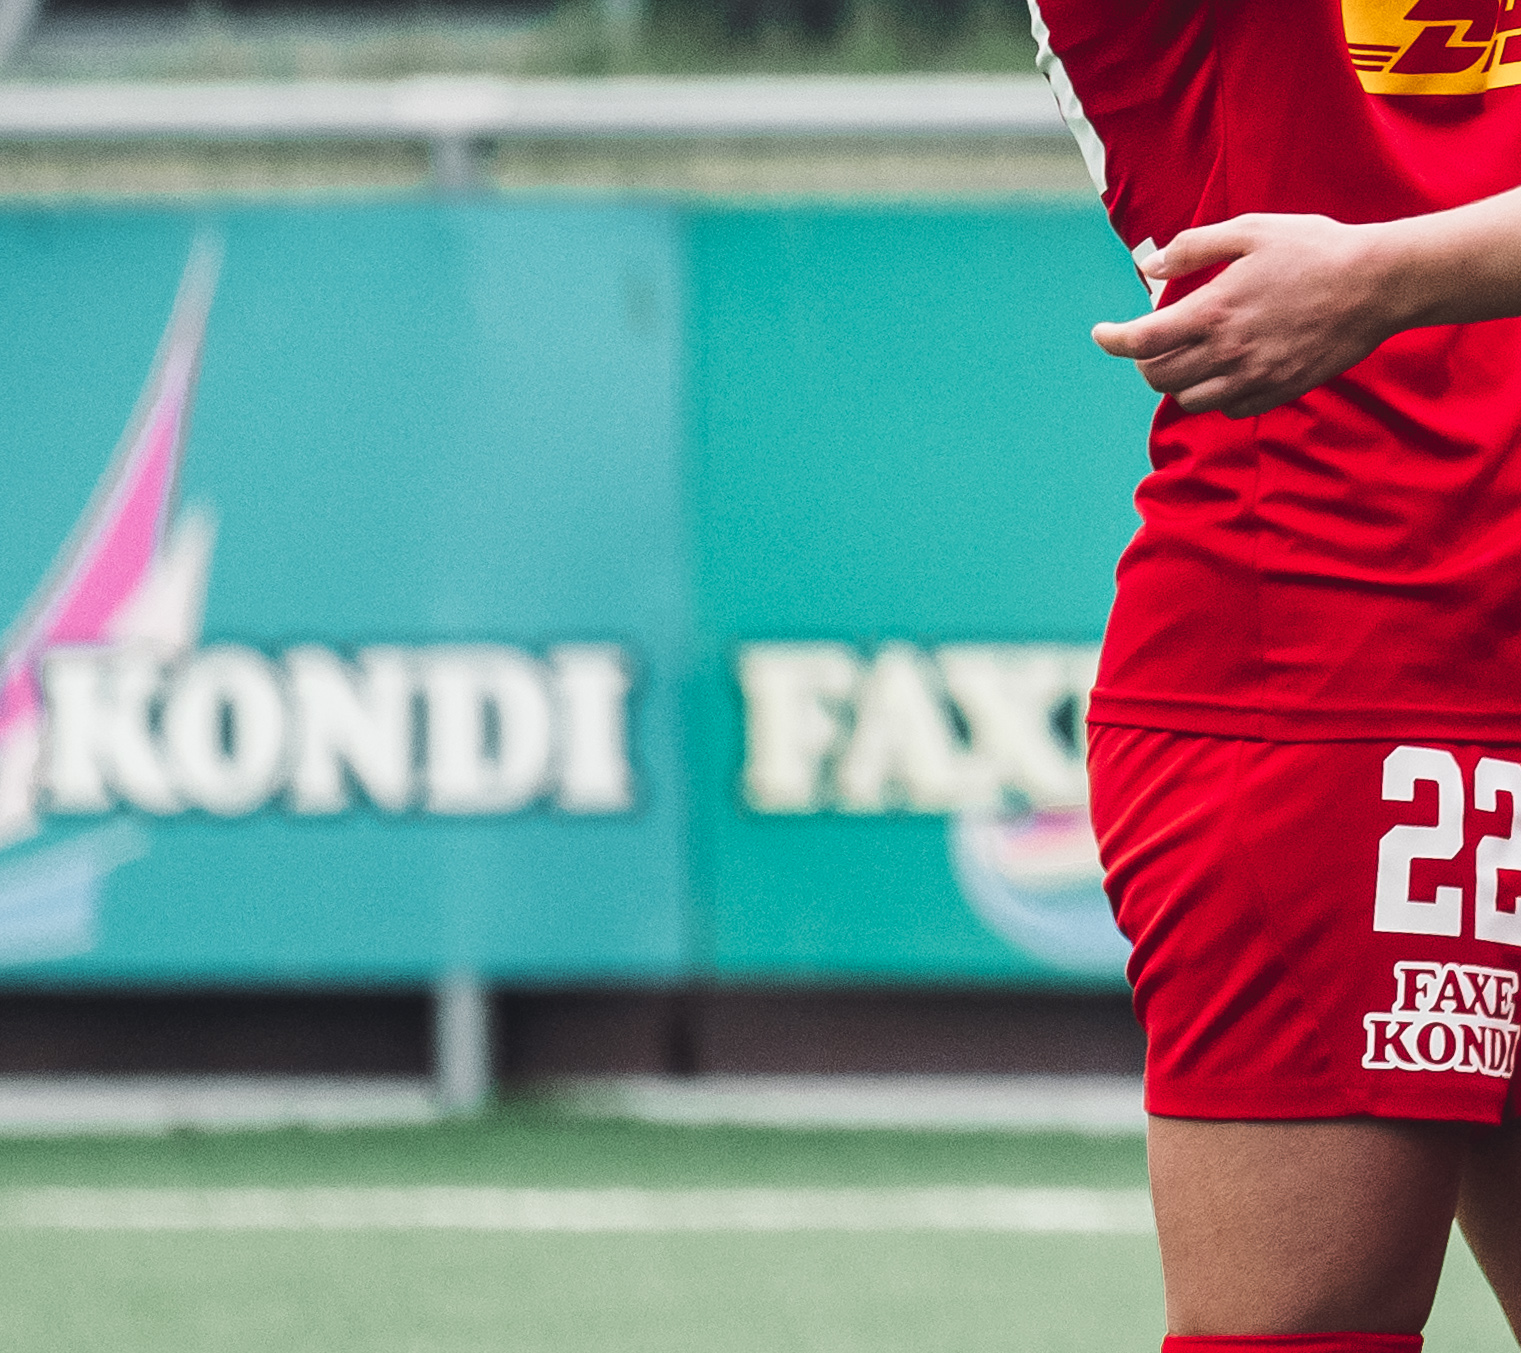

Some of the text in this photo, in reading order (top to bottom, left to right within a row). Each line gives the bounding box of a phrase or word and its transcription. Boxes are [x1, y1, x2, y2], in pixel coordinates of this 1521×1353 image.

[46, 646, 634, 816] KONDI
[738, 641, 1100, 814] FAX
[1362, 1012, 1521, 1079] KONDI
[1394, 961, 1519, 1023] FAXE
